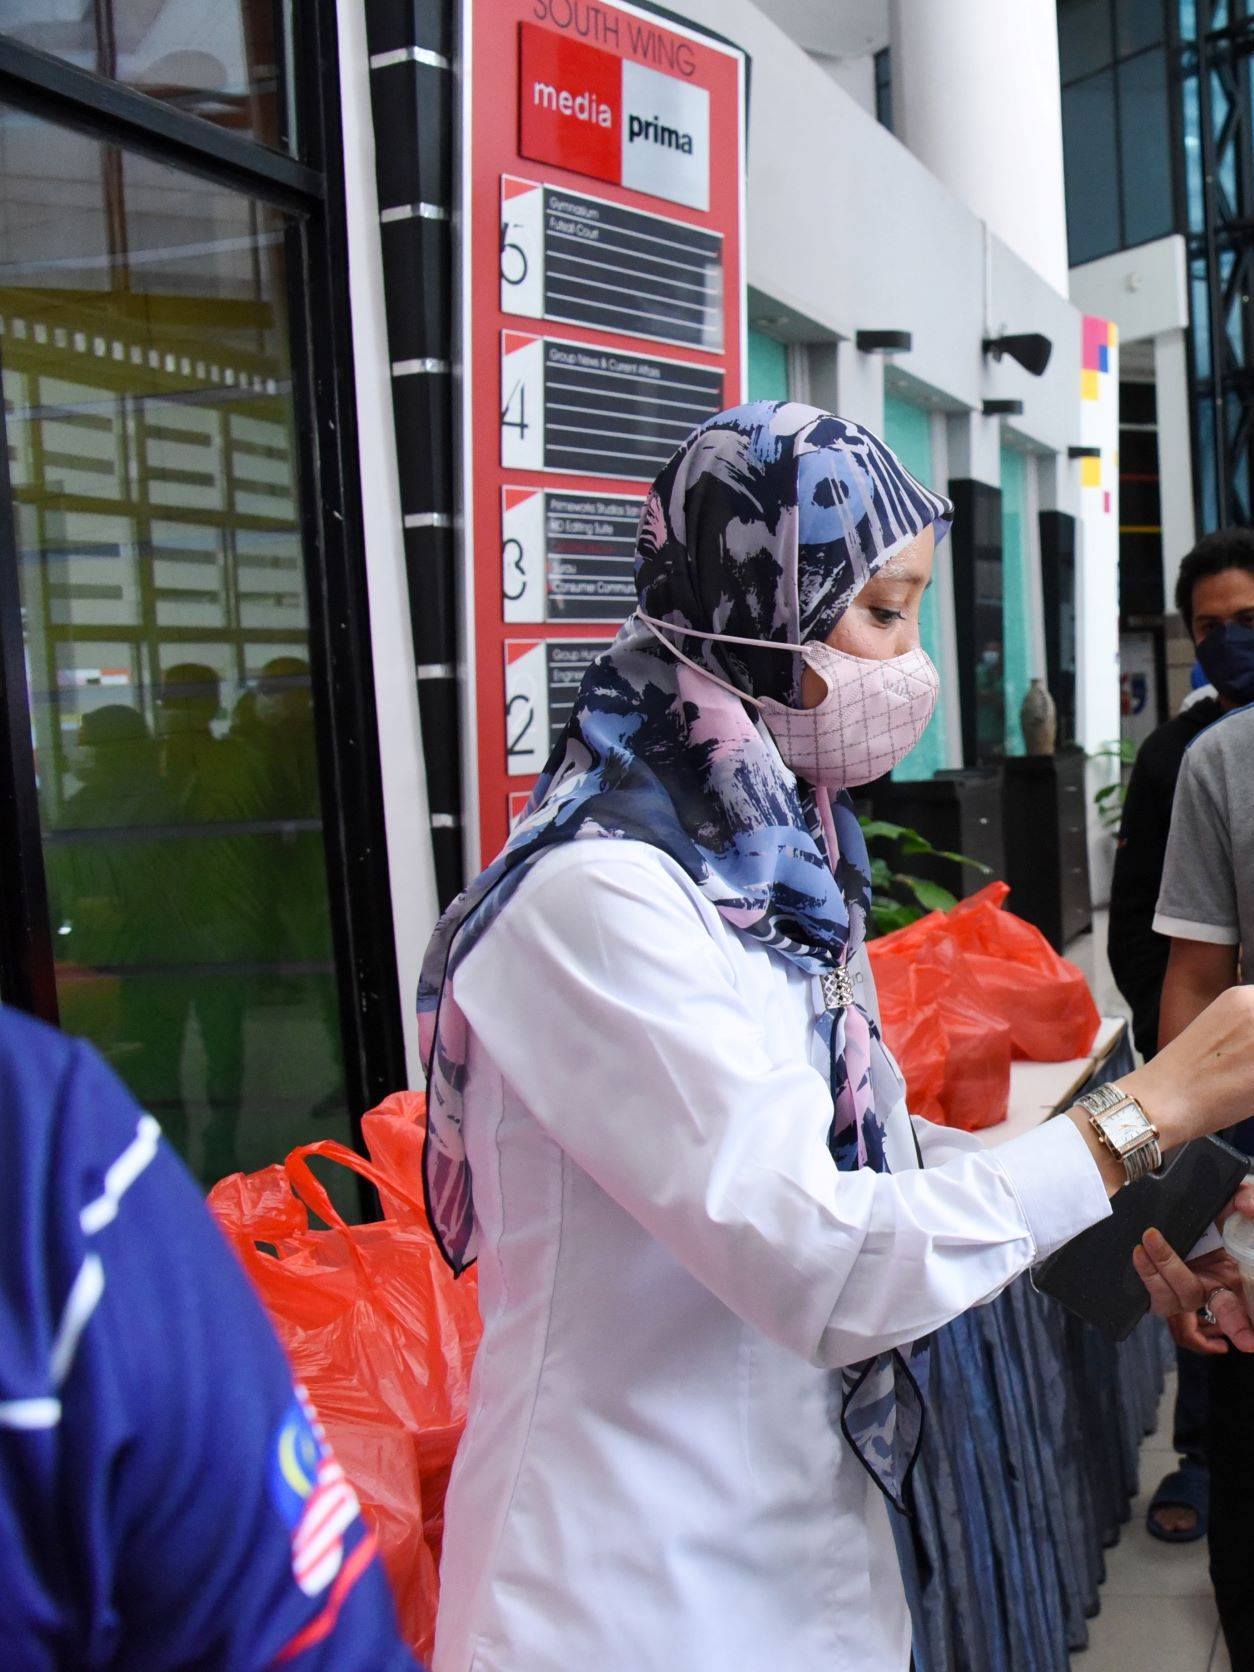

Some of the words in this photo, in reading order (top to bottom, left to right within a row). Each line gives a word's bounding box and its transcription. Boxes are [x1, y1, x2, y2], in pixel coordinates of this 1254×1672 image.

[533, 0, 620, 48] SOUTH
[628, 22, 697, 77] WING
[533, 80, 612, 128] media
[628, 114, 694, 154] prima
[549, 347, 577, 364] Group
[502, 379, 529, 440] 4
[502, 538, 527, 600] 3
[507, 694, 535, 756] 2
